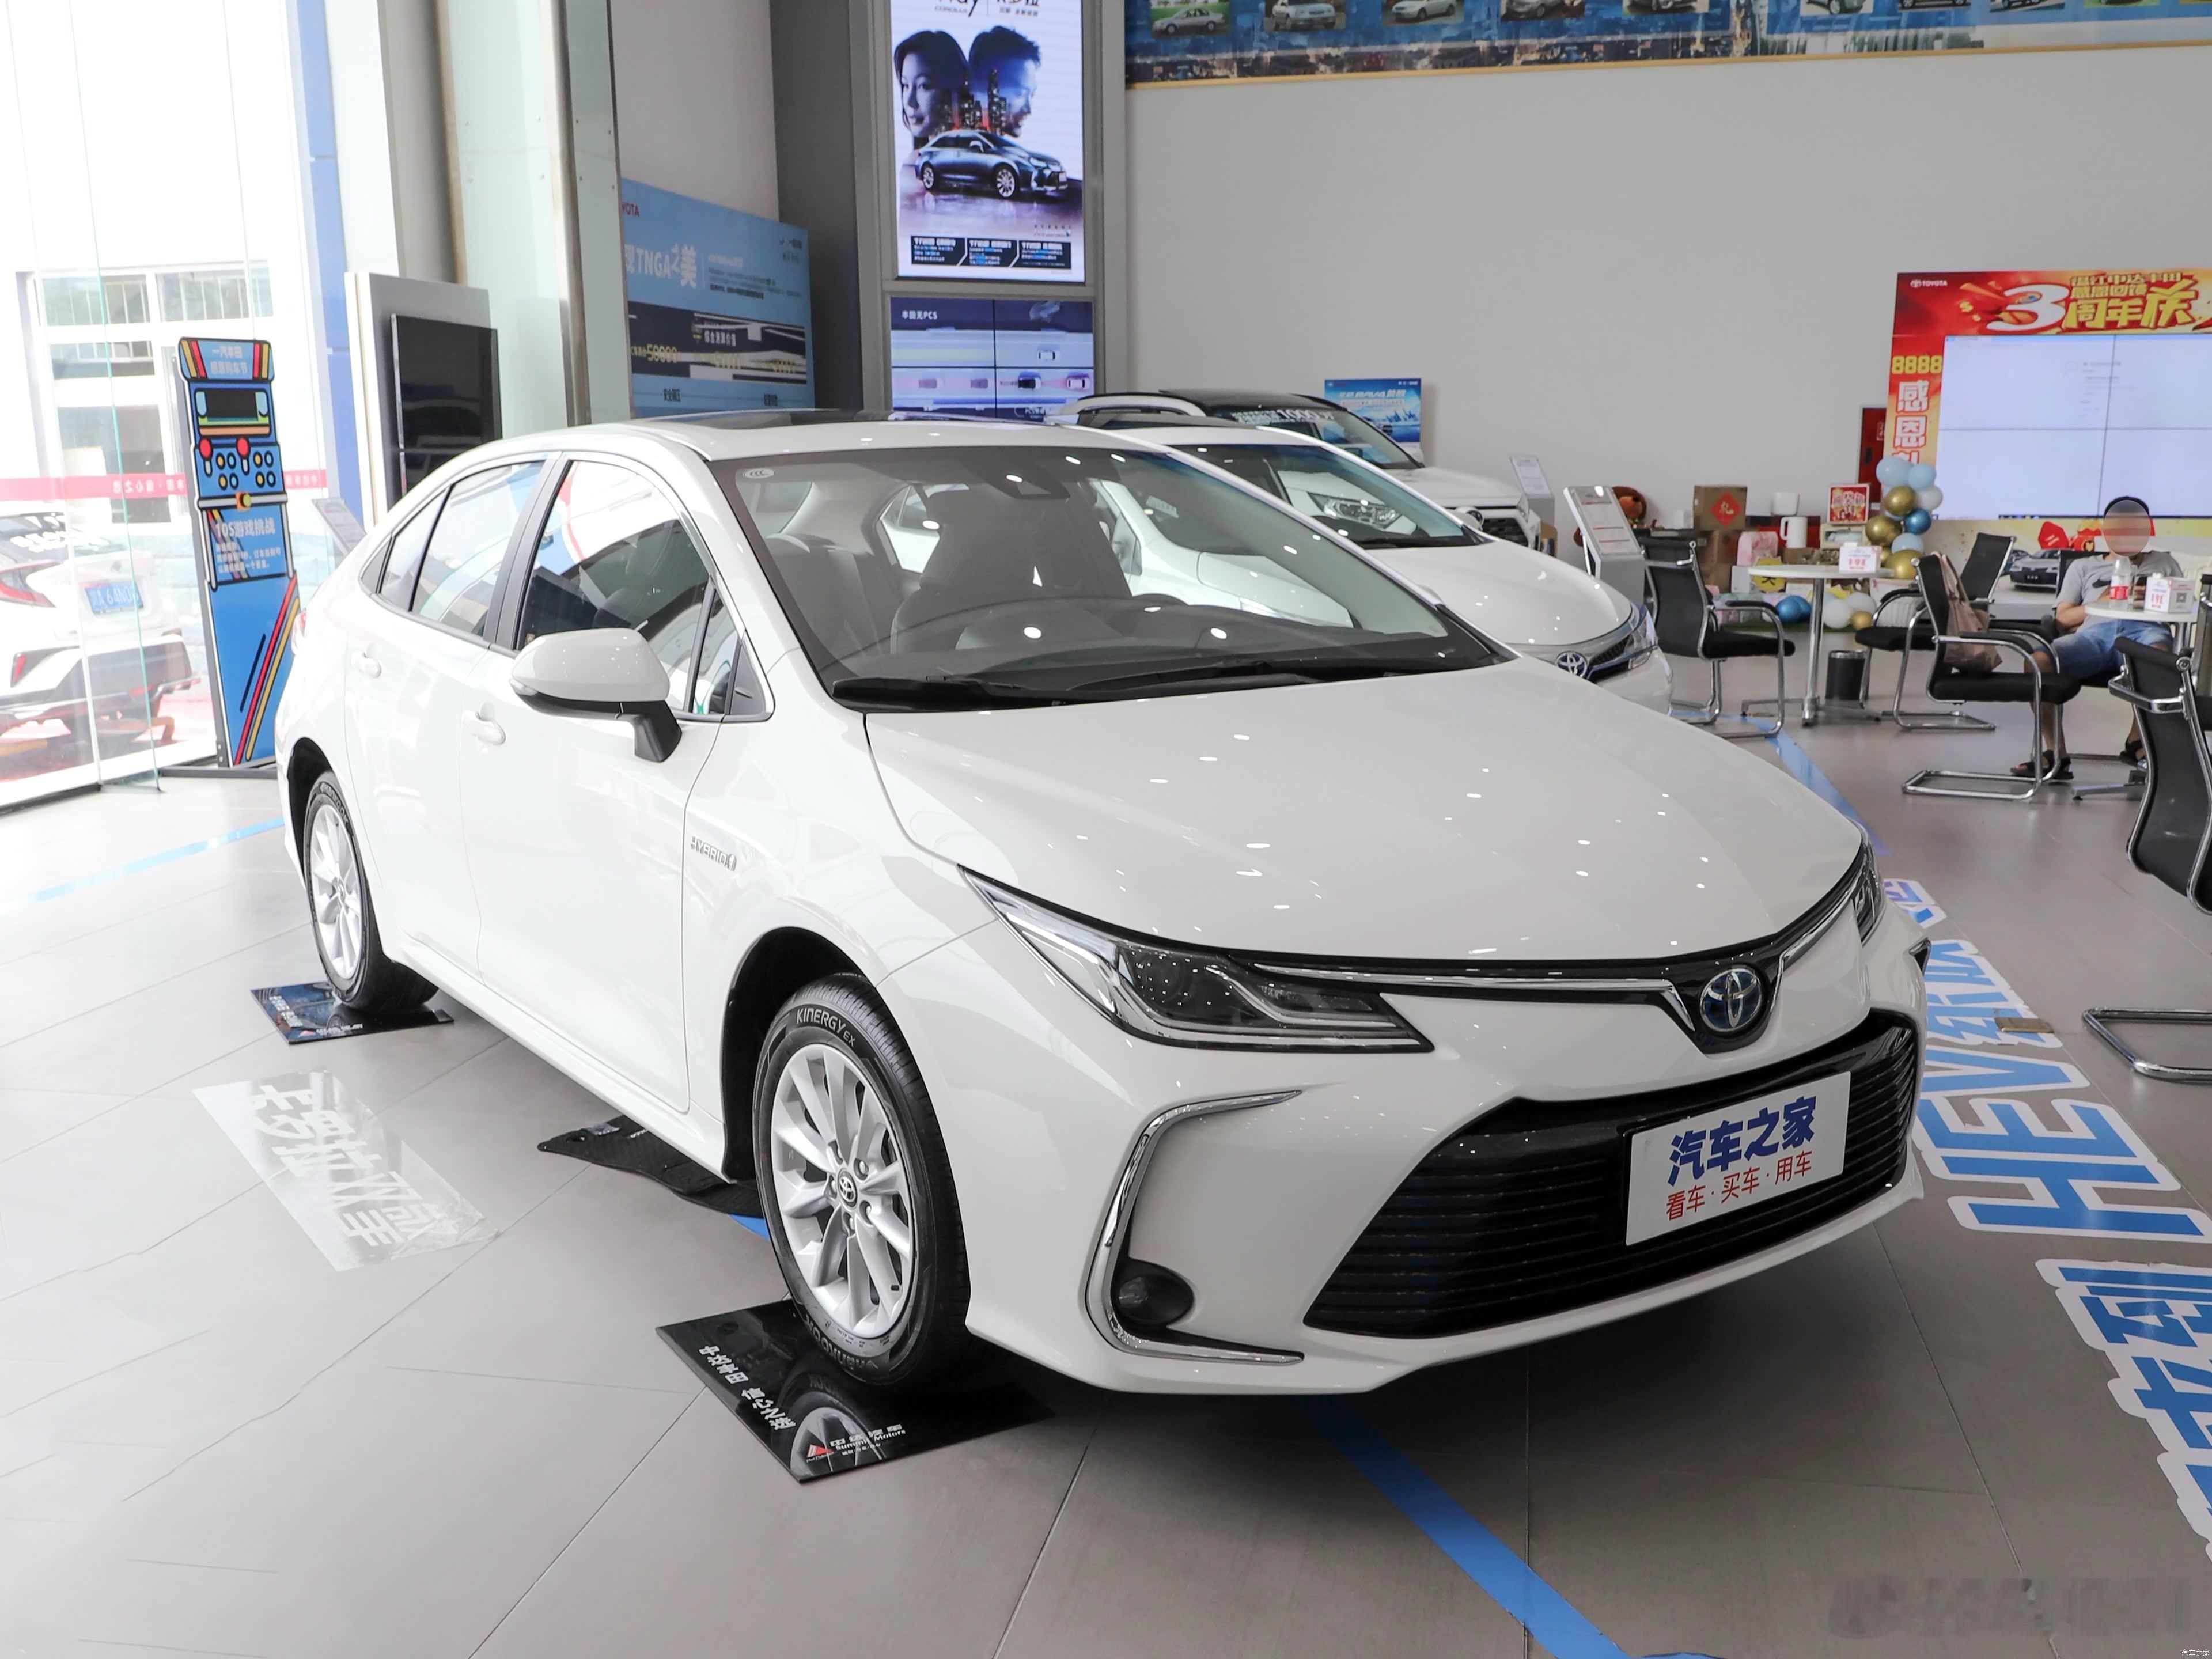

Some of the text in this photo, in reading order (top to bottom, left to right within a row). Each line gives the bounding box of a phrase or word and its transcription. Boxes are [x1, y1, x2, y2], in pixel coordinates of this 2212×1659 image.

[1892, 355, 1943, 374] 8888
[796, 1007, 856, 1047] KINERGY EX
[1667, 1095, 1816, 1187] 汽车之家
[873, 1429, 906, 1442] Motors
